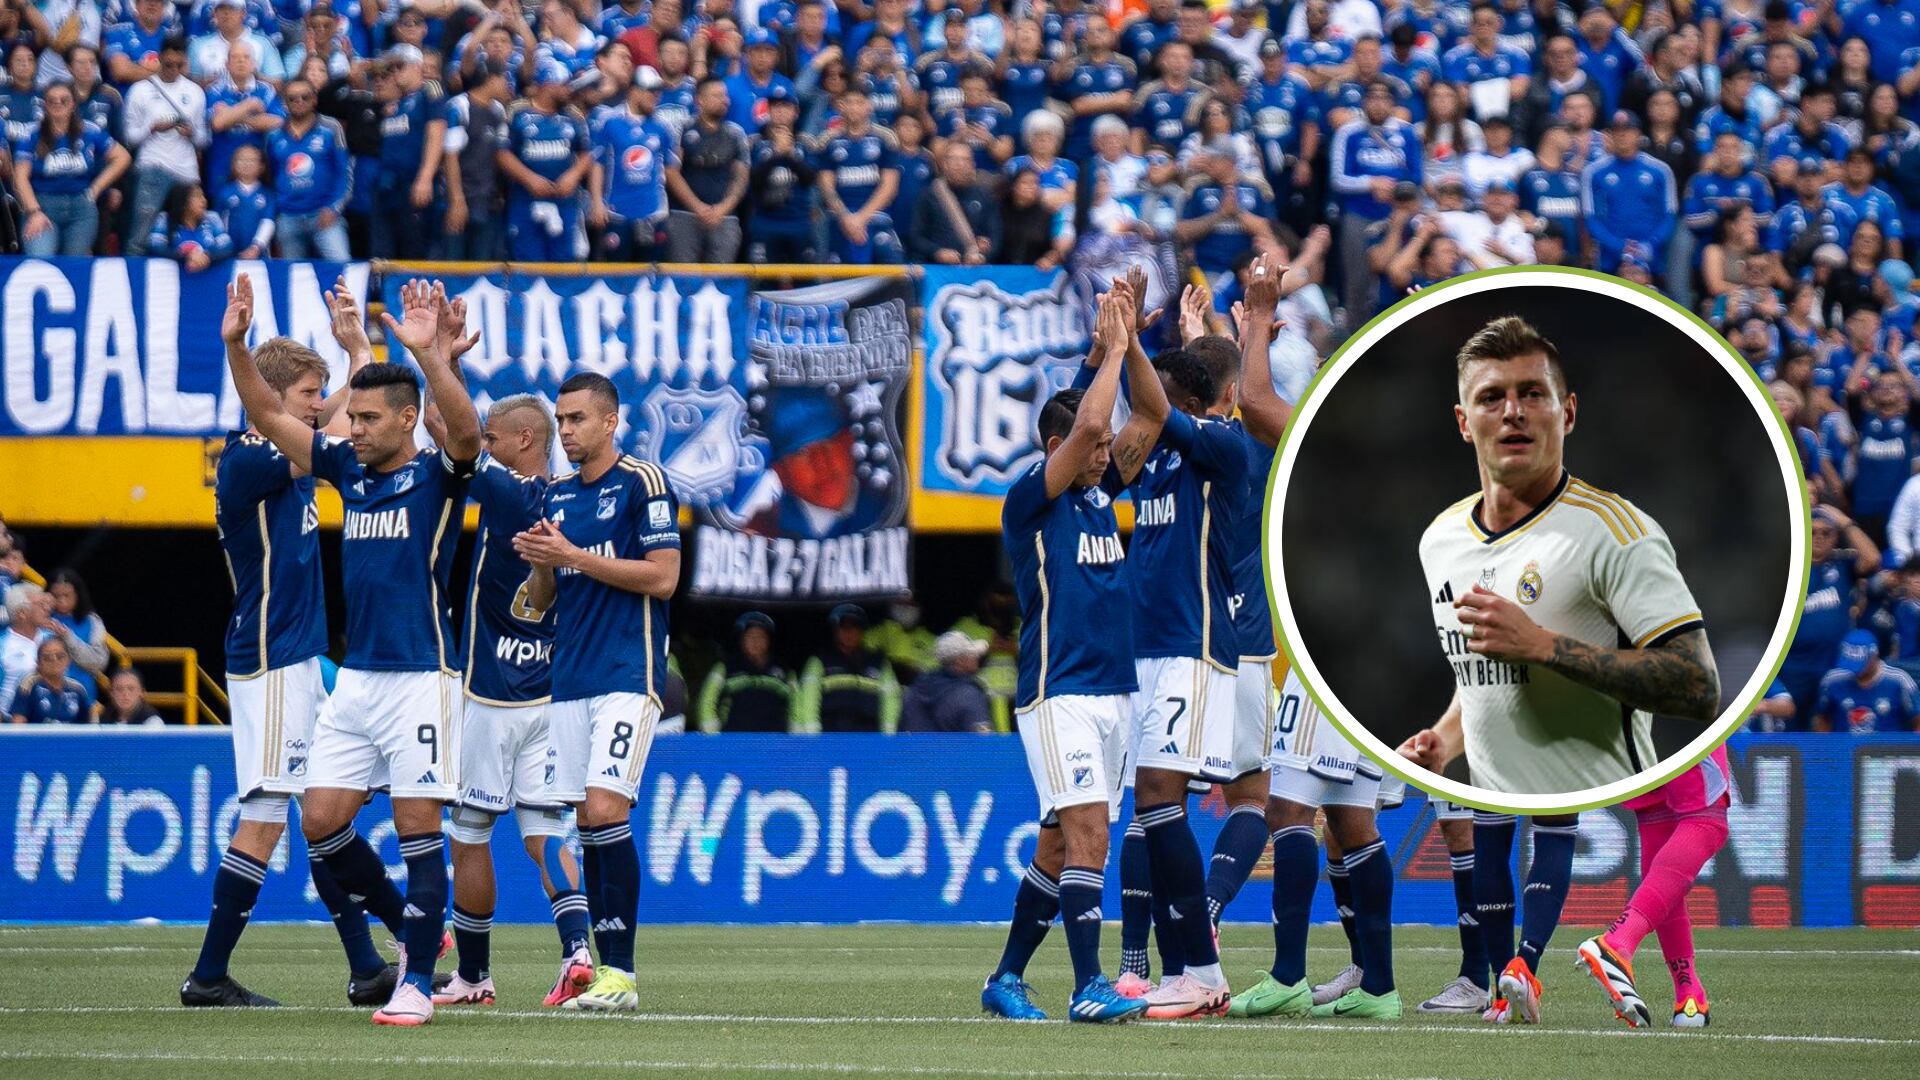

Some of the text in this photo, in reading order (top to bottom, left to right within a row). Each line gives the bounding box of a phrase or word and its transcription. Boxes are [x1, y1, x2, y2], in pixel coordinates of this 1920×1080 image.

[946, 357, 1036, 476] 16
[1477, 659, 1530, 686] BETTER
[1166, 696, 1186, 735] 7
[417, 723, 437, 764] 9
[608, 720, 633, 760] 8
[468, 787, 504, 805] Allianz
